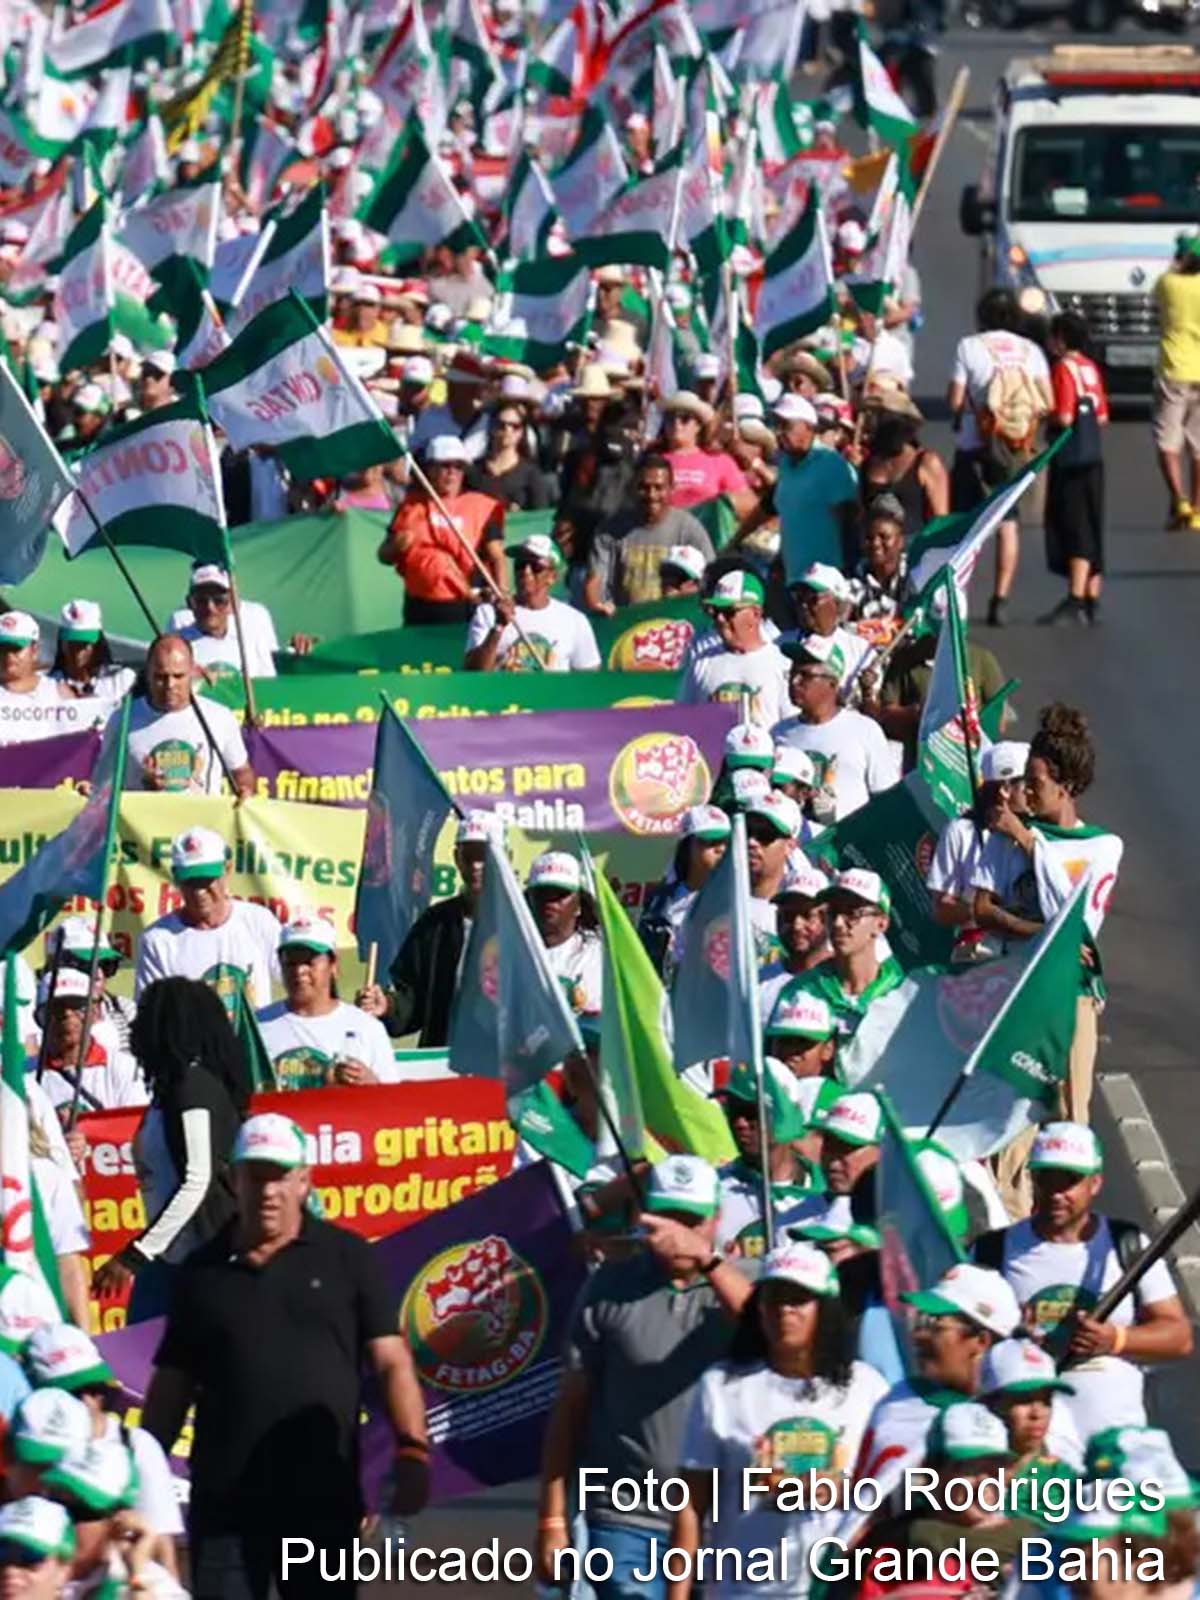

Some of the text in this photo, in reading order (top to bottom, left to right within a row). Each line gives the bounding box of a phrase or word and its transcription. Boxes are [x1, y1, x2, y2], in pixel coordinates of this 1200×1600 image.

[1, 705, 78, 721] socorro
[513, 762, 586, 796] para
[321, 1165, 499, 1220] produçã
